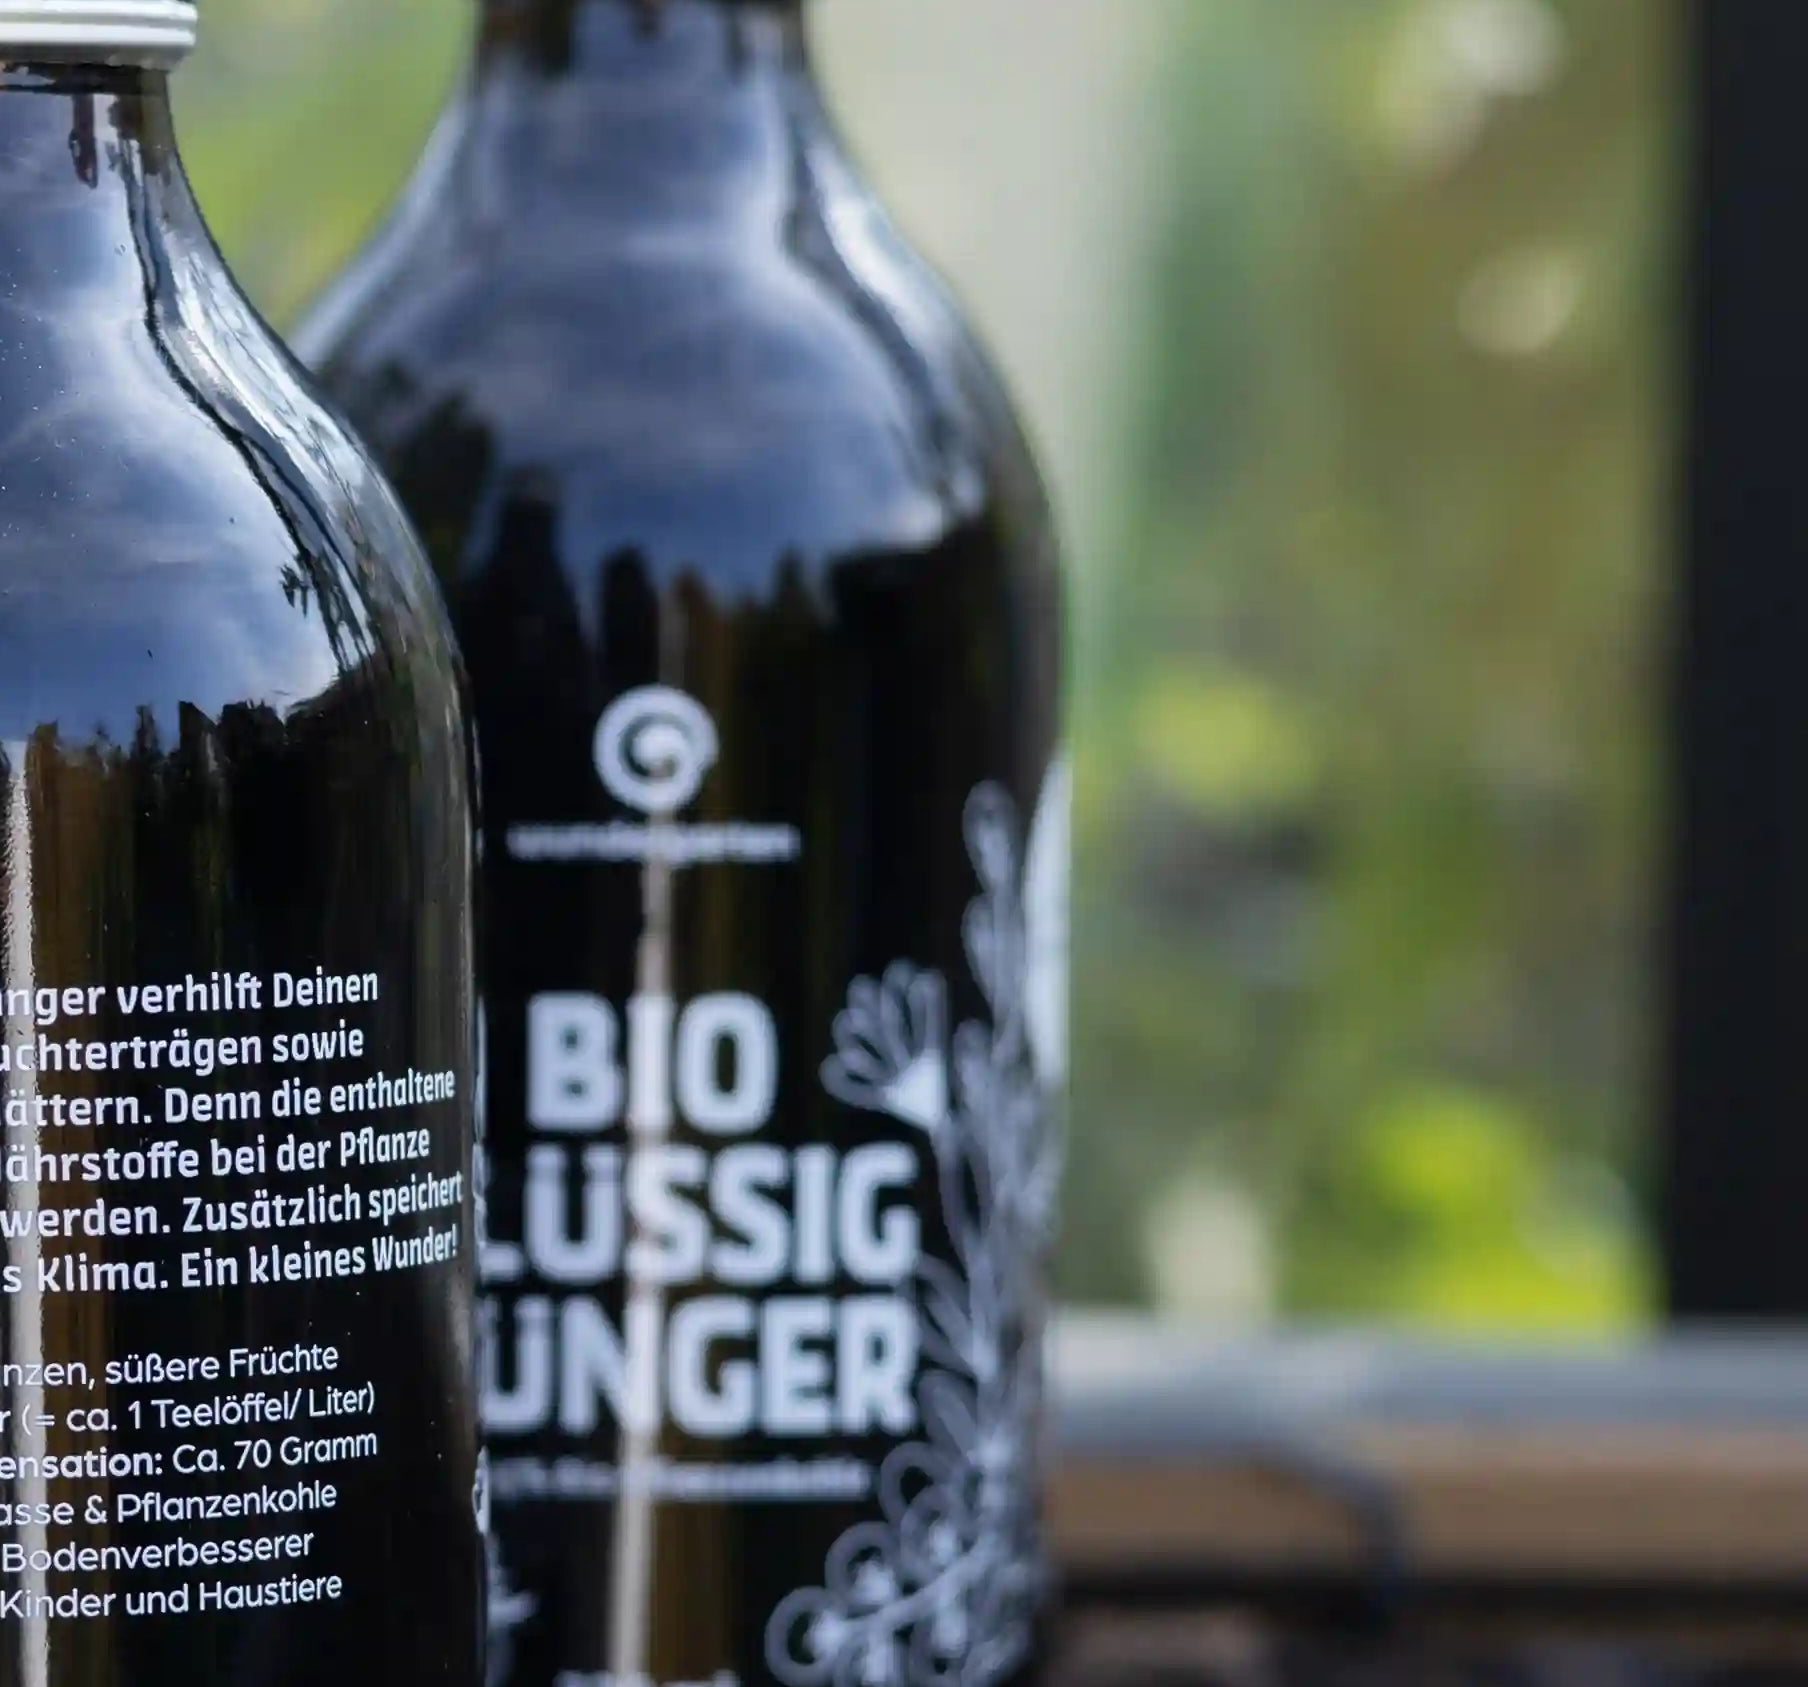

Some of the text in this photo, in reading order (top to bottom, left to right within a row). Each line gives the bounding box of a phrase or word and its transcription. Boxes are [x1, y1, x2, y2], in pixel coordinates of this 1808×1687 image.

[118, 972, 261, 1014] verhilft
[273, 967, 378, 1008] Deinen
[273, 1020, 364, 1062] sowie
[527, 993, 779, 1133] BIO
[165, 1087, 261, 1124] Denn
[272, 1079, 321, 1116] die
[330, 1067, 456, 1113] enthaltene
[211, 1134, 265, 1176] bei
[277, 1134, 331, 1172] der
[341, 1126, 430, 1168] Pflanze
[0, 1198, 171, 1238] werden.
[183, 1183, 361, 1233] Zusätzlich
[370, 1171, 463, 1225] speichert
[481, 1141, 918, 1286] ÜSSIG
[38, 1254, 169, 1293] Klima.
[182, 1248, 238, 1288] Ein
[249, 1243, 365, 1284] kleines
[373, 1225, 457, 1271] Wunder!
[105, 1353, 220, 1385] süßere
[230, 1343, 339, 1379] Früchte
[480, 1293, 916, 1436] ÜNGER
[66, 1406, 117, 1432] ca.
[129, 1400, 142, 1429] 1
[309, 1381, 375, 1419] Liter)
[172, 1445, 225, 1474] Ca.
[234, 1439, 271, 1470] 70
[280, 1432, 377, 1466] Gramm
[84, 1494, 107, 1525] &
[117, 1480, 337, 1525] Pflanzenkohle
[1, 1530, 314, 1574] Bodenverbesserer
[0, 1588, 115, 1620] Kinder
[126, 1584, 189, 1615] und
[199, 1573, 342, 1613] Haustiere
